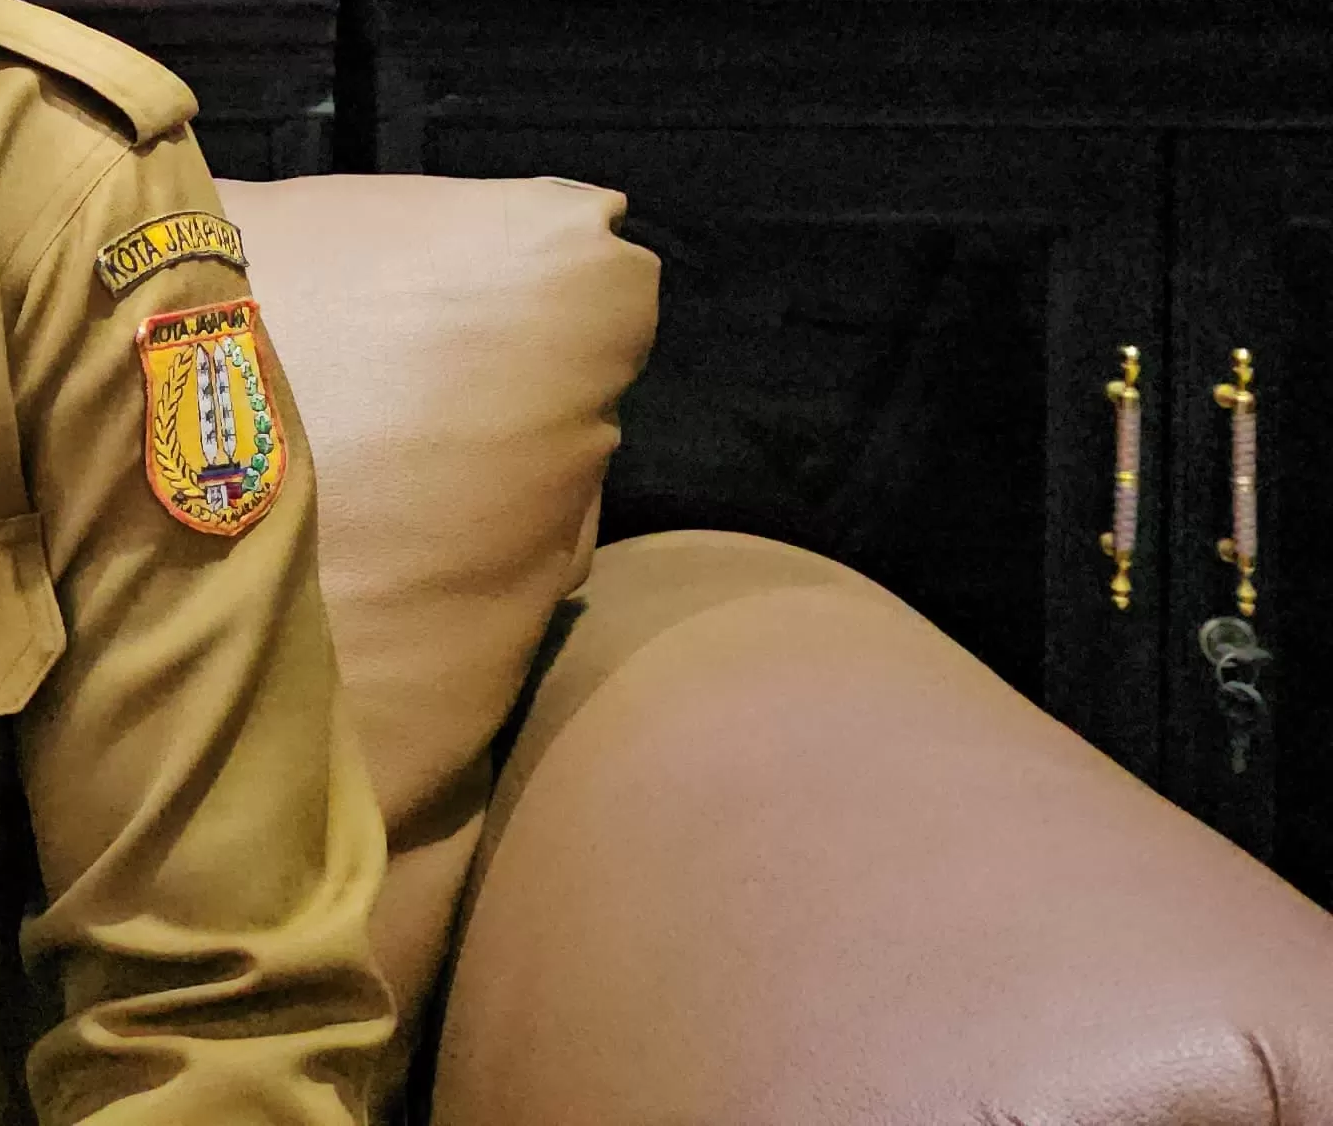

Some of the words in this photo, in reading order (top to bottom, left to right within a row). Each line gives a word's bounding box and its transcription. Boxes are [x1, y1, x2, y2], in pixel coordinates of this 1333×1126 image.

[105, 232, 162, 284] KOTA
[165, 217, 244, 260] JAYAPURA
[150, 318, 189, 345] KOTA
